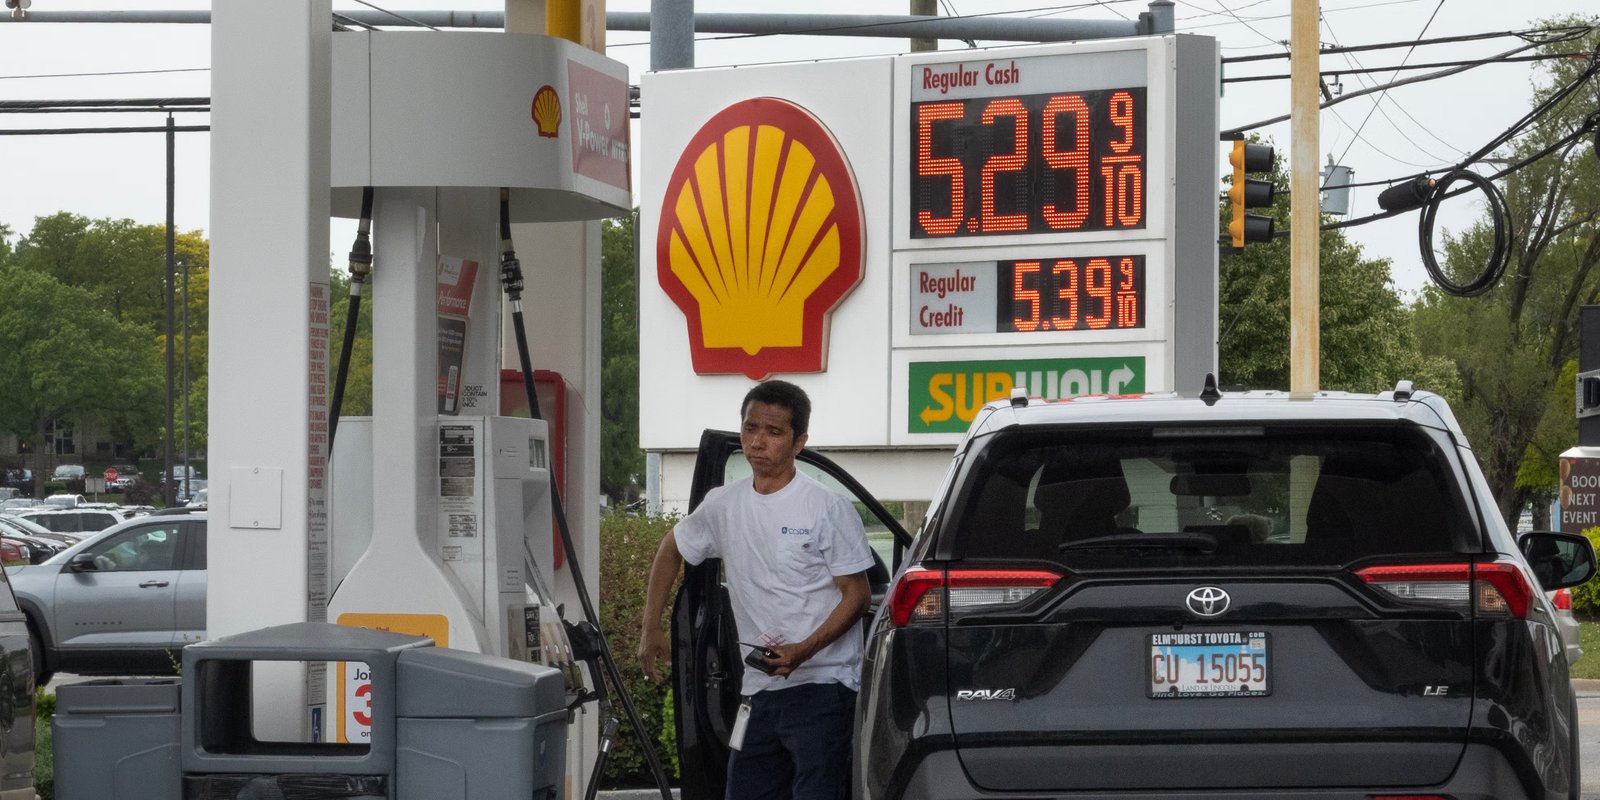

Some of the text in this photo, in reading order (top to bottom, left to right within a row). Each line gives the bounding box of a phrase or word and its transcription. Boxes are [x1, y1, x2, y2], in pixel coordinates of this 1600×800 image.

[922, 60, 1020, 94] Regular Cash
[575, 92, 588, 116] Shell
[576, 117, 609, 157] V-Power
[918, 95, 1089, 234] 5.29
[919, 269, 976, 299] Regular
[1013, 259, 1112, 331] 5.39
[919, 303, 964, 328] Credit
[1568, 493, 1597, 506] NEXT
[1562, 511, 1598, 524] EVENT
[1152, 633, 1203, 645] ELMHURST
[1204, 633, 1242, 645] TOYOTA
[1152, 653, 1265, 684] CU 15055
[956, 687, 1016, 701] RAV4
[1423, 685, 1449, 696] LE
